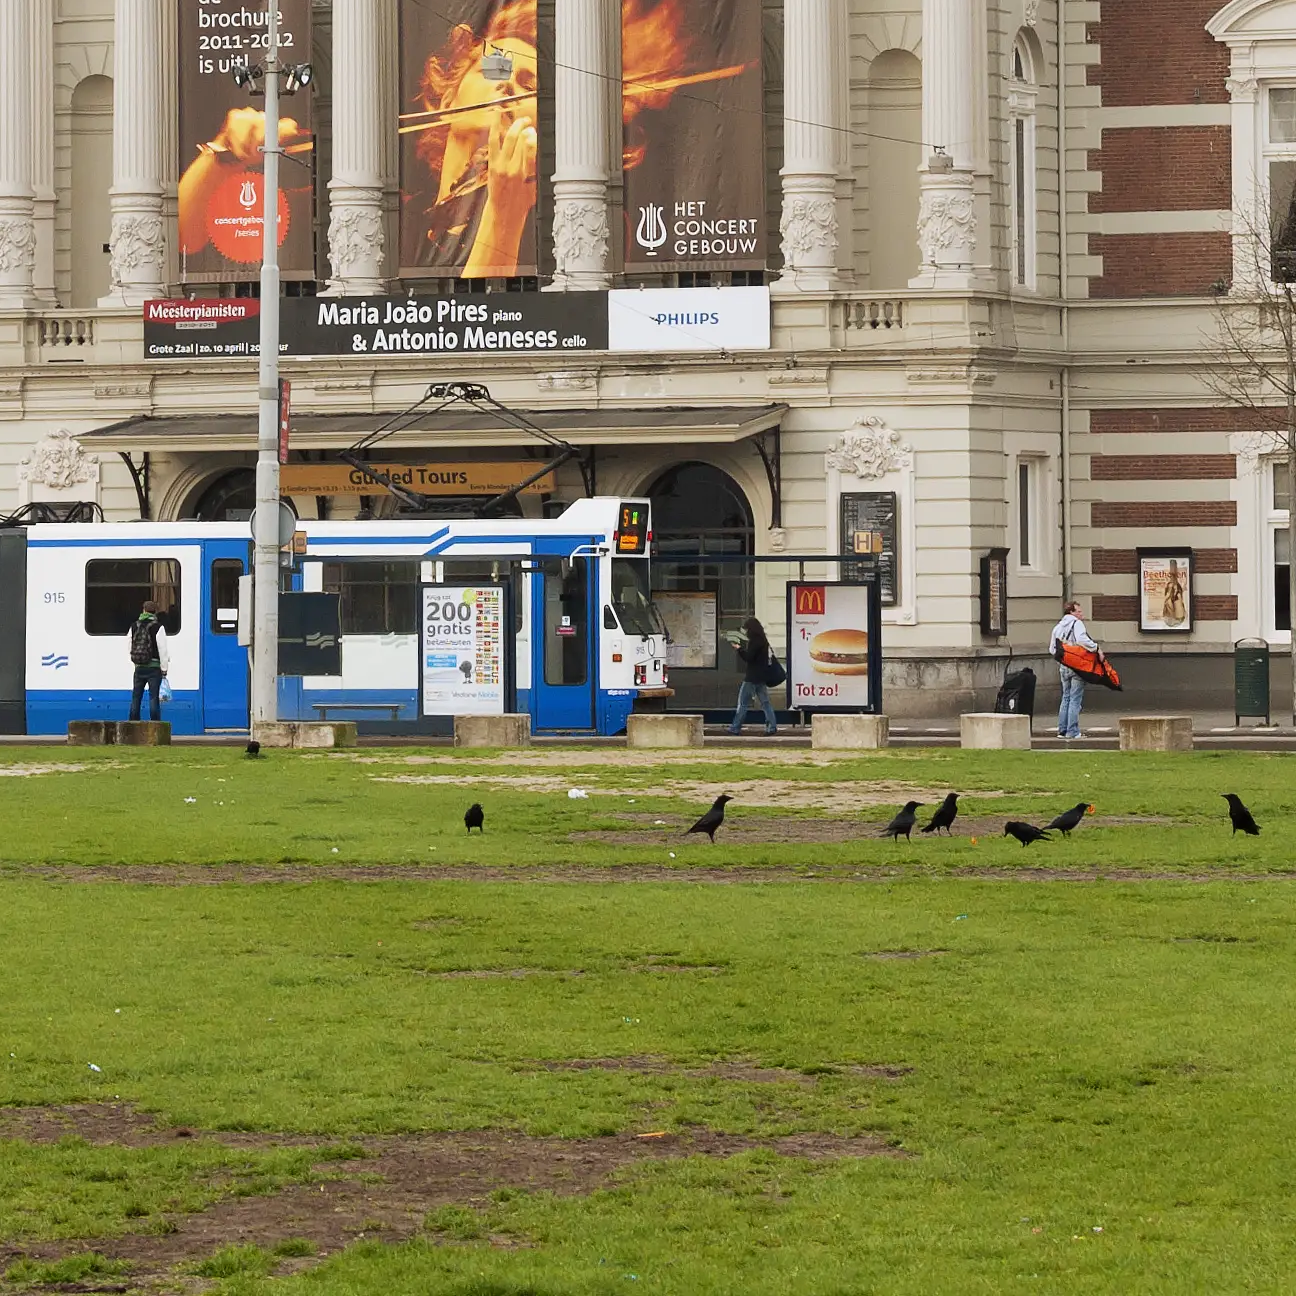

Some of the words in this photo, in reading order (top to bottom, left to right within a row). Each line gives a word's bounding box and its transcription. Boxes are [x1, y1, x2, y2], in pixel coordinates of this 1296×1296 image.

[199, 55, 214, 74] is
[674, 201, 706, 217] HET
[674, 219, 758, 236] CONCERT
[674, 239, 757, 255] GEBOUW
[149, 303, 246, 320] Meesterpianisten
[318, 302, 379, 325] Maria
[383, 300, 432, 324] João
[437, 299, 488, 322] Pires
[492, 310, 522, 324] piano
[657, 313, 719, 325] PHILIPS
[352, 334, 368, 351] &
[372, 327, 458, 351] Antonio
[464, 327, 557, 349] Meneses
[562, 335, 587, 347] cello
[149, 344, 174, 354] Grote
[175, 344, 194, 353] Zaal
[224, 342, 245, 354] april
[415, 469, 468, 484] Tours
[622, 508, 631, 527] 5
[856, 534, 870, 550] H
[44, 592, 65, 603] 915
[426, 602, 472, 622] 200
[427, 622, 472, 638] gratis
[796, 684, 816, 696] Tot
[819, 684, 838, 696] zo!
